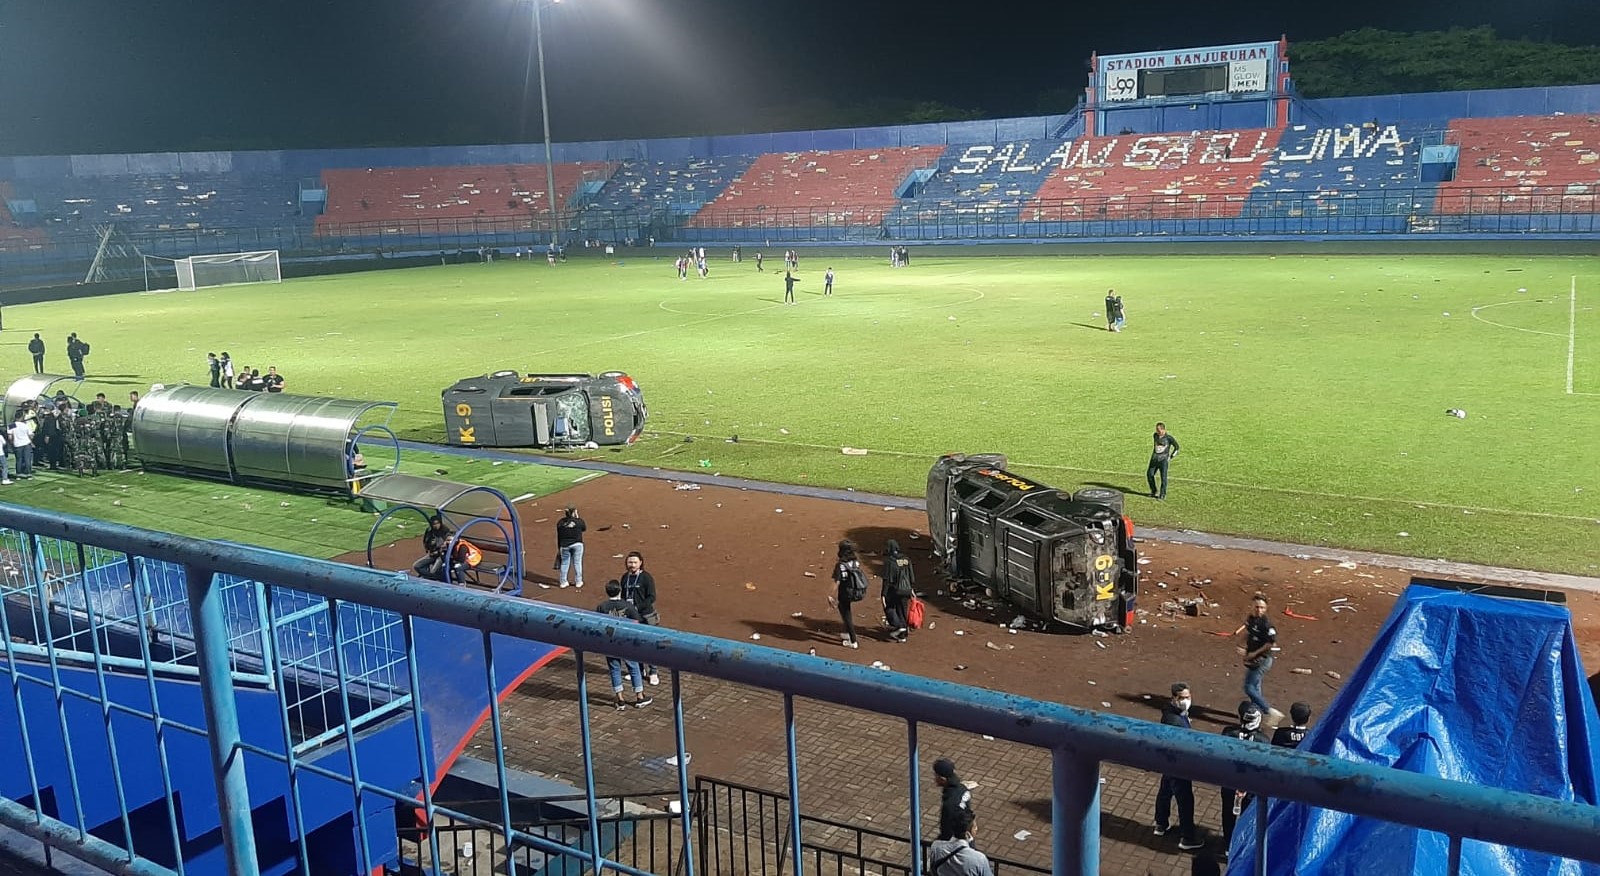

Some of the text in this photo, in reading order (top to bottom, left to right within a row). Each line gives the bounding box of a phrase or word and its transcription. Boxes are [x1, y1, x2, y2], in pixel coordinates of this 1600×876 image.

[1107, 48, 1267, 70] STADION KANJURUHAN
[1233, 72, 1260, 81] GLOW
[1279, 125, 1404, 161] JIWA
[456, 403, 475, 444] K-9
[602, 395, 615, 437] POLISI
[1095, 554, 1115, 601] K-9
